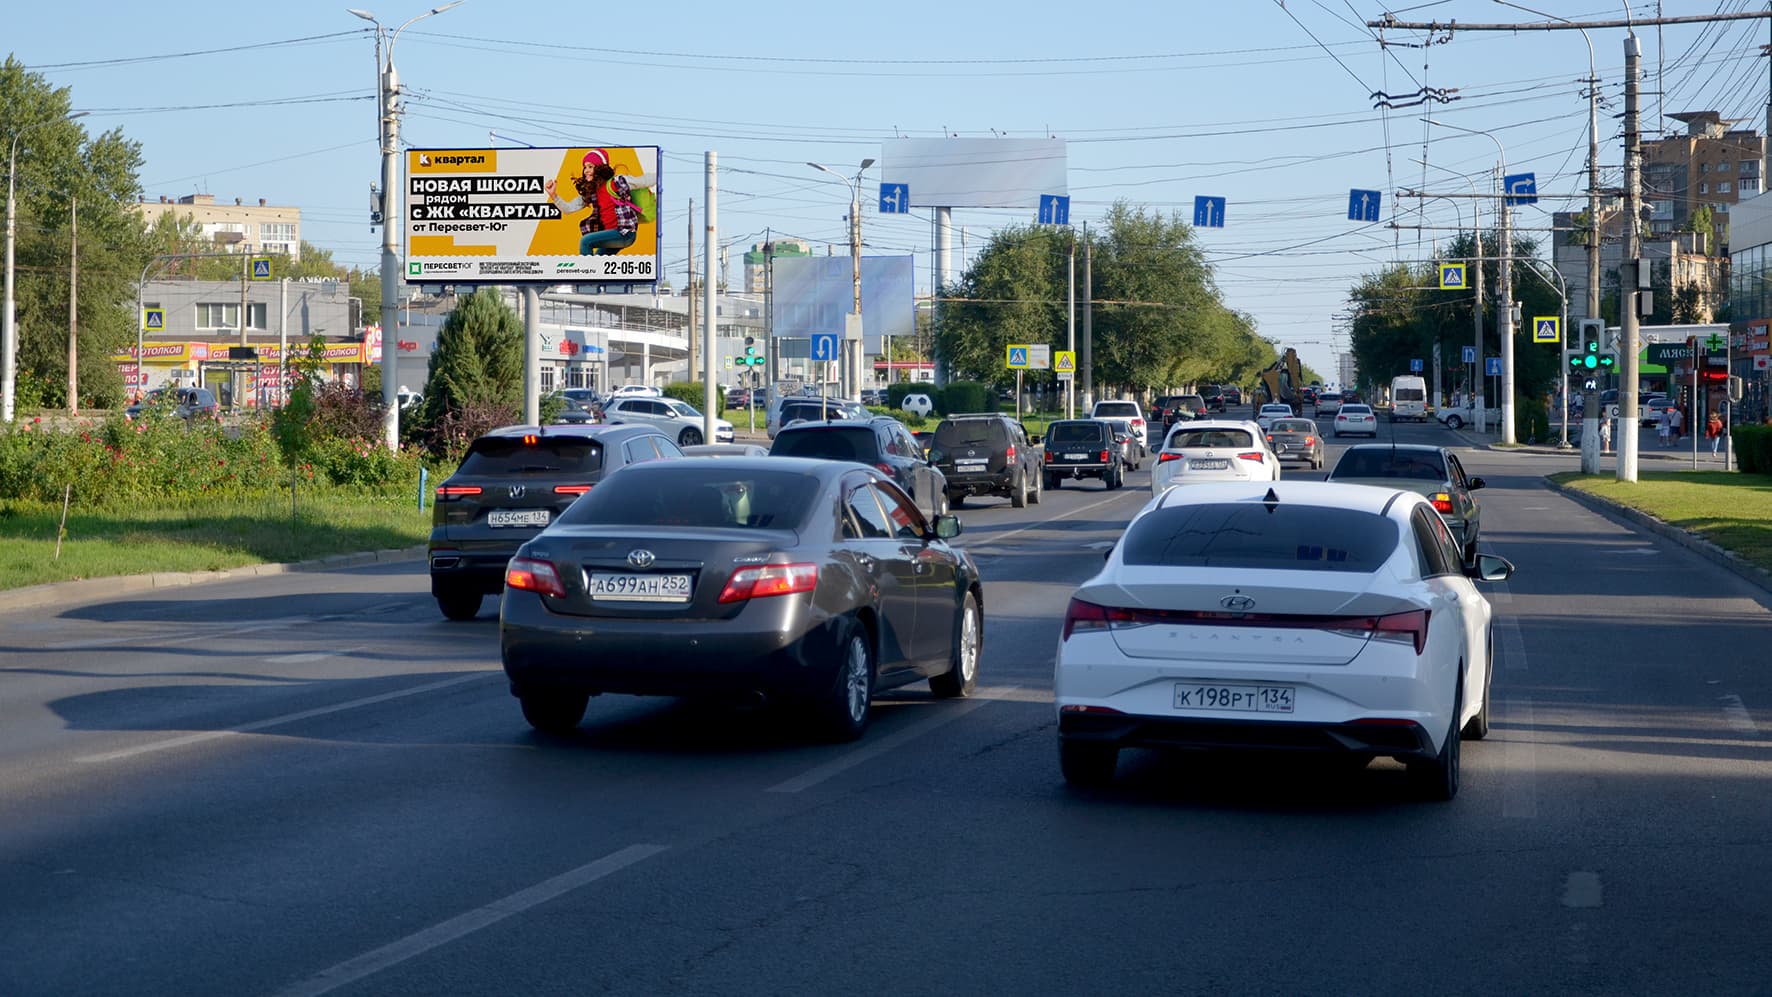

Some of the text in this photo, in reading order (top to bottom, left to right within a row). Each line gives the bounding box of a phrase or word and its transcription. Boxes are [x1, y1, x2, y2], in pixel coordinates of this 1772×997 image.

[434, 155, 485, 166] квартал
[413, 178, 542, 192] НОВАЯ ШКОЛА
[426, 194, 467, 205] рядом
[426, 206, 455, 218] ЖК
[459, 205, 560, 218] «КВАРТАЛ»
[413, 222, 508, 234] от Пересвет-Юг
[603, 260, 653, 276] 22-05-06
[662, 576, 687, 589] 252
[1180, 687, 1291, 707] К198РТ 134
